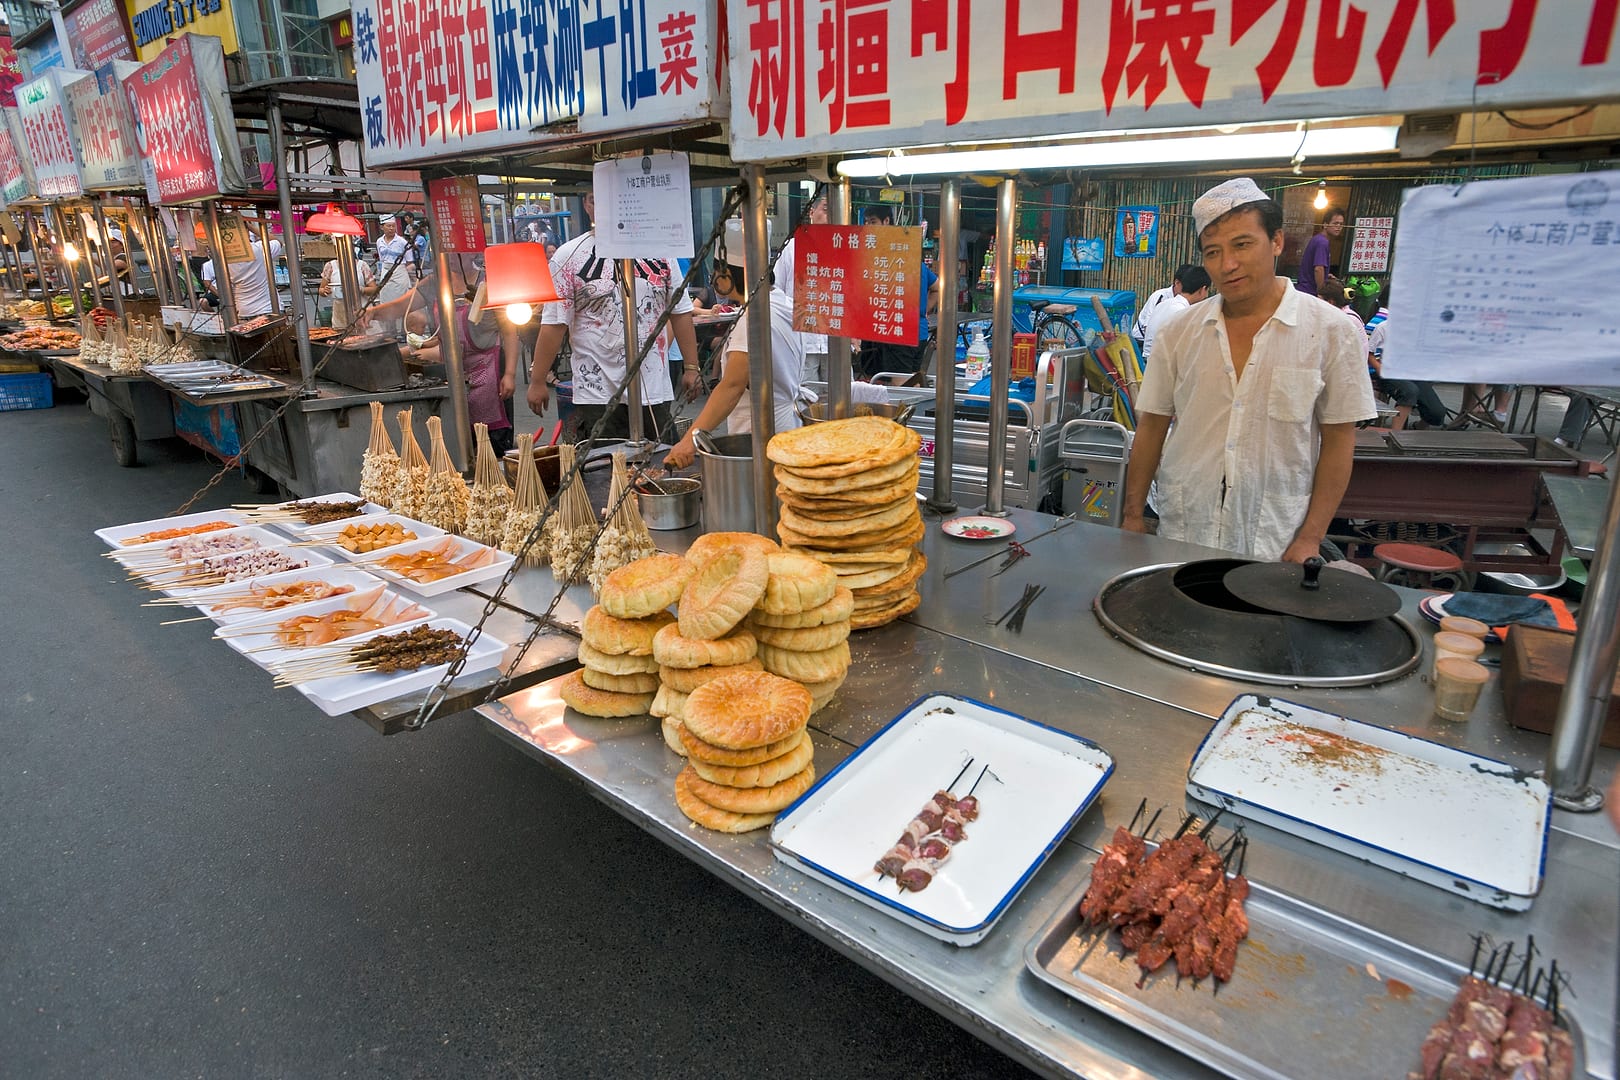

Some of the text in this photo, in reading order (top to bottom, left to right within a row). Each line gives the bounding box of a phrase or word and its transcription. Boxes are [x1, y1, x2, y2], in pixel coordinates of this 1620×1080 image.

[132, 0, 174, 47] SUNING
[658, 11, 698, 96] 菜
[355, 8, 387, 150] 铁板
[1356, 229, 1390, 238] 五香味
[1486, 219, 1620, 246] 个体工商户营
[832, 232, 877, 249] 价格表
[1354, 240, 1388, 249] 麻辣味
[1352, 251, 1386, 260] 海鲜味
[874, 257, 905, 269] 3元/个
[863, 269, 905, 283] 2.5元/串
[873, 283, 905, 297] 2元/串
[868, 296, 904, 310] 10元/串
[873, 310, 904, 324] 4元/串
[873, 323, 903, 337] 7元/串
[919, 440, 935, 454] 天
